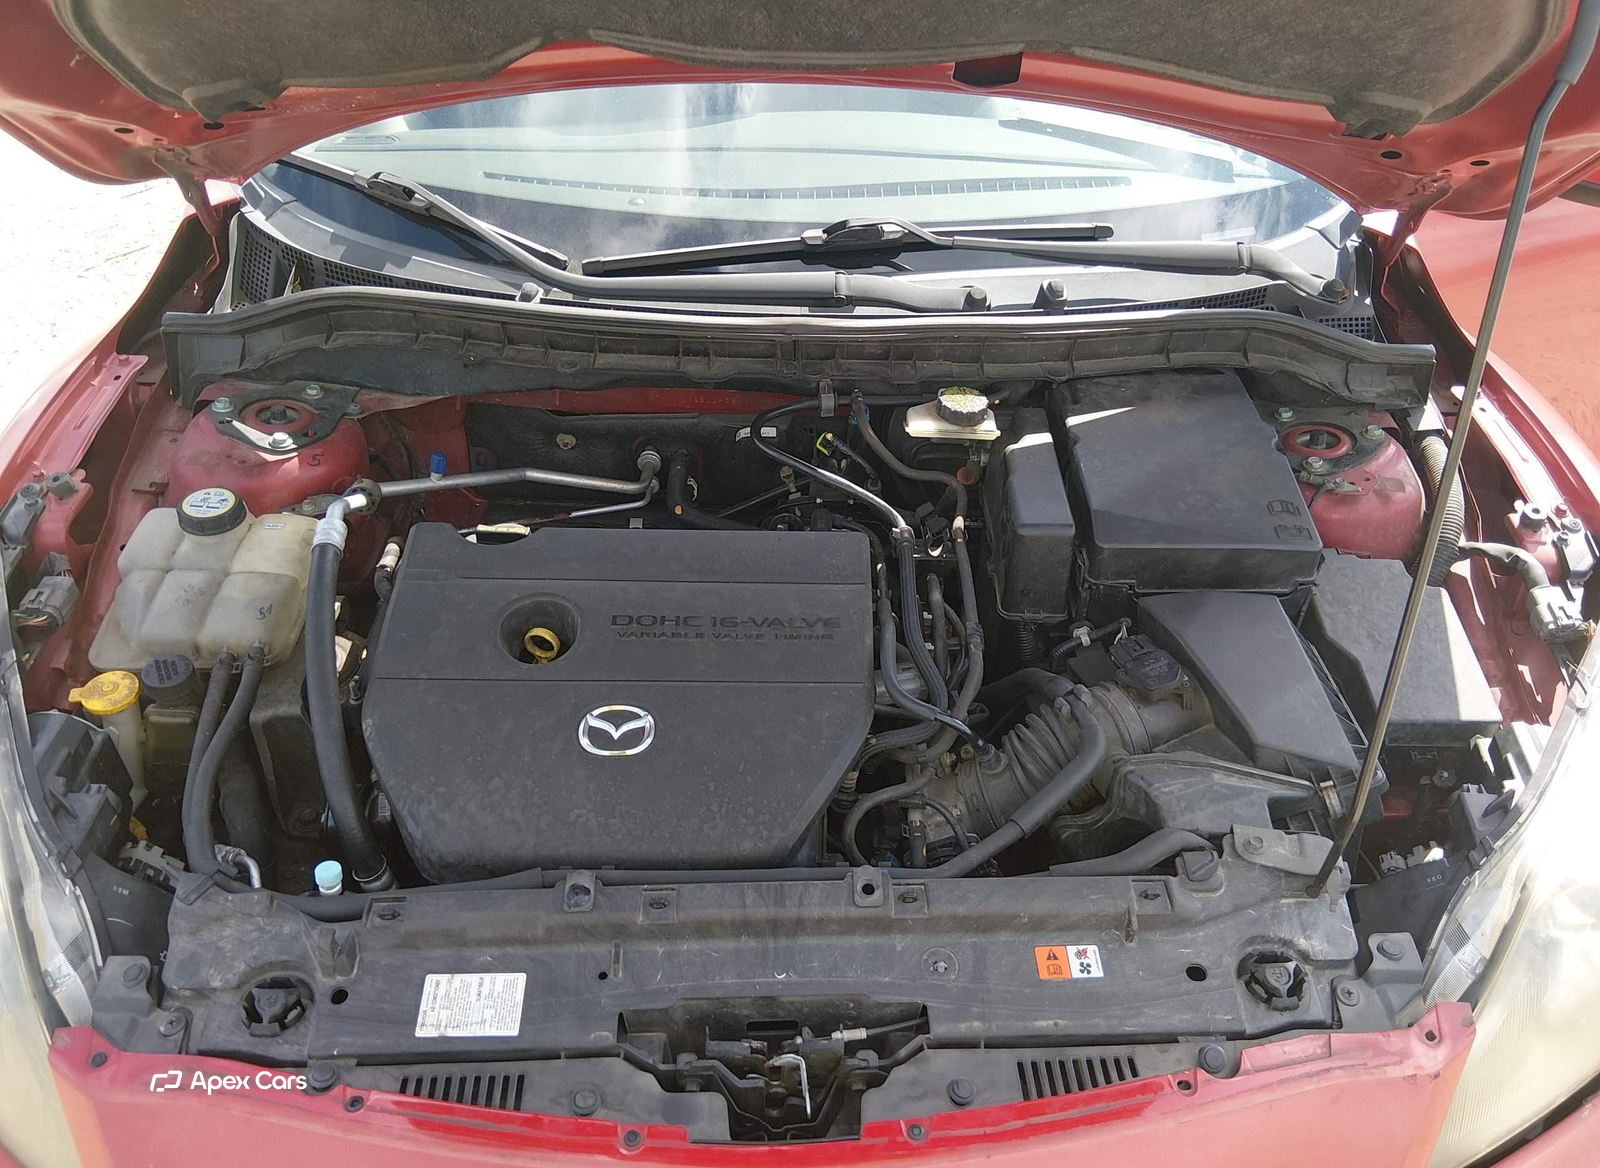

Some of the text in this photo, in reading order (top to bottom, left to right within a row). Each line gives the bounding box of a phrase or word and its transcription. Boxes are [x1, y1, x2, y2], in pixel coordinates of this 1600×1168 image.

[610, 614, 842, 630] DOHC 16-VALVE
[616, 631, 706, 640] VARIABLE
[711, 632, 766, 641] VALVE
